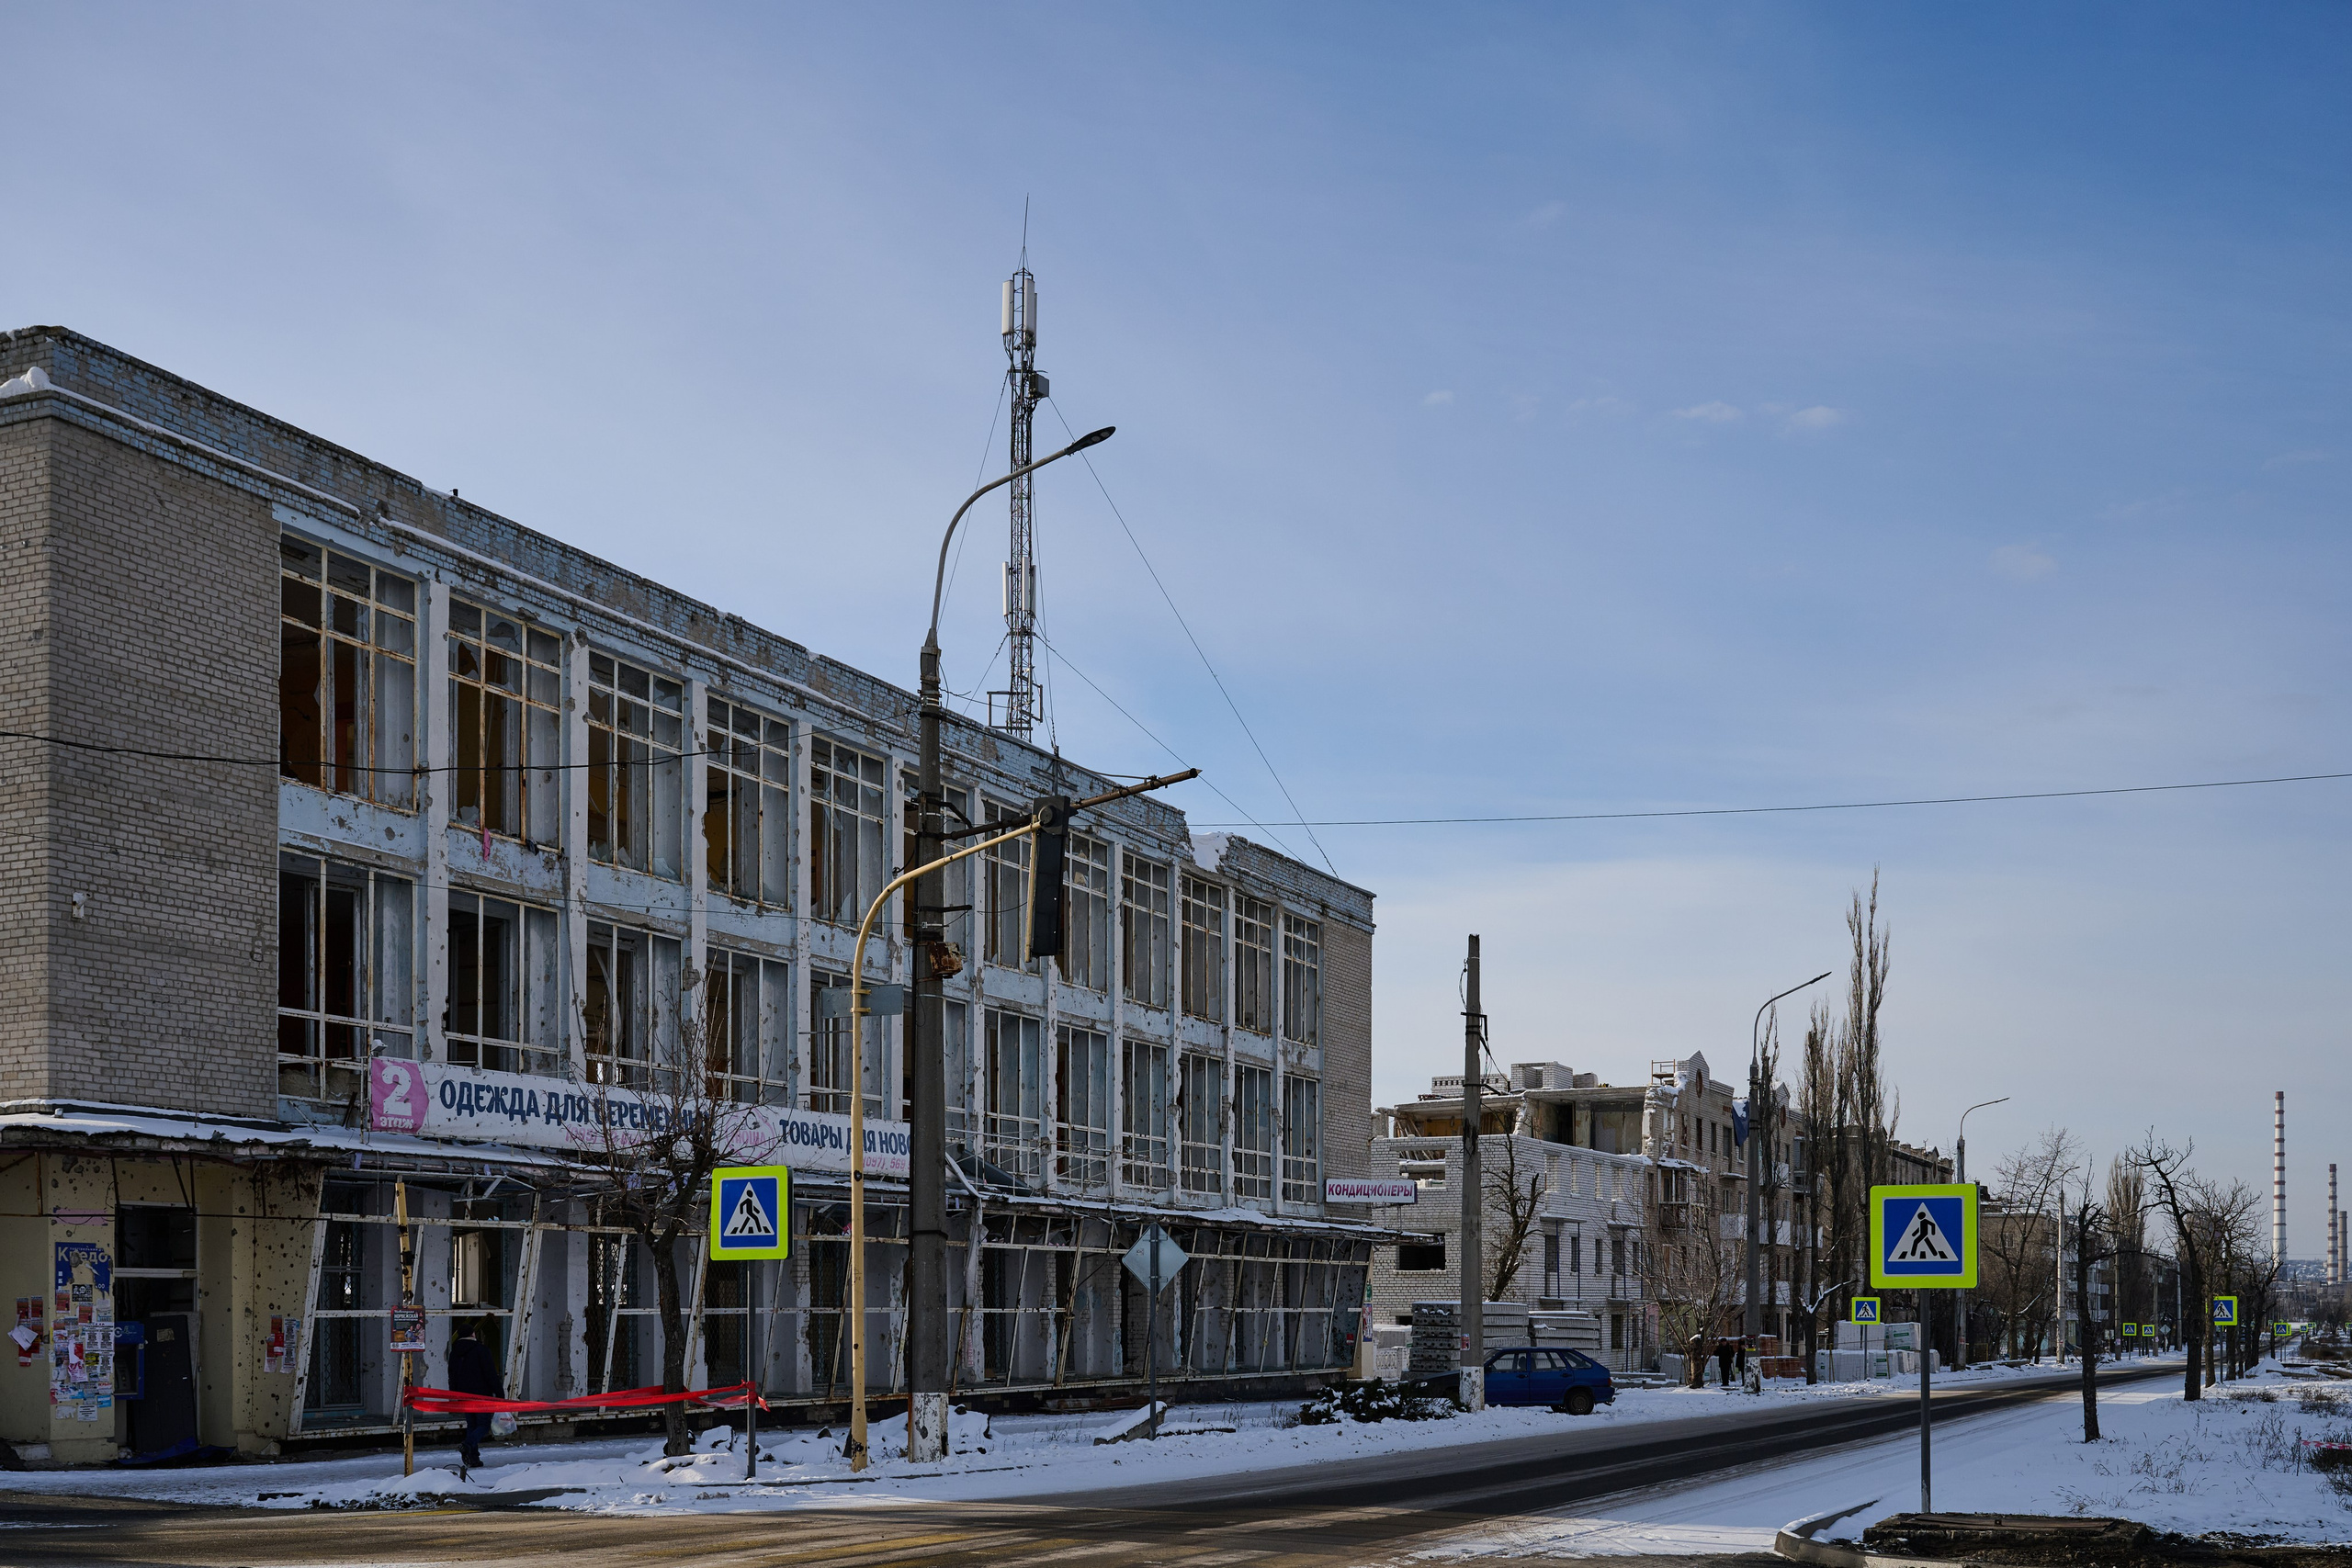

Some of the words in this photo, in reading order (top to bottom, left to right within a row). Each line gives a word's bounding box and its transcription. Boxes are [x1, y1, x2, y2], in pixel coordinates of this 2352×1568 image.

[381, 1066, 413, 1116] 2
[439, 1079, 541, 1122] ОДЕЖДА
[545, 1091, 590, 1127] ДЛЯ
[779, 1119, 842, 1150] ТОВАРЫ
[1329, 1183, 1413, 1198] КОНДИЦИОНЕРЫ
[58, 1247, 108, 1265] Кедо
